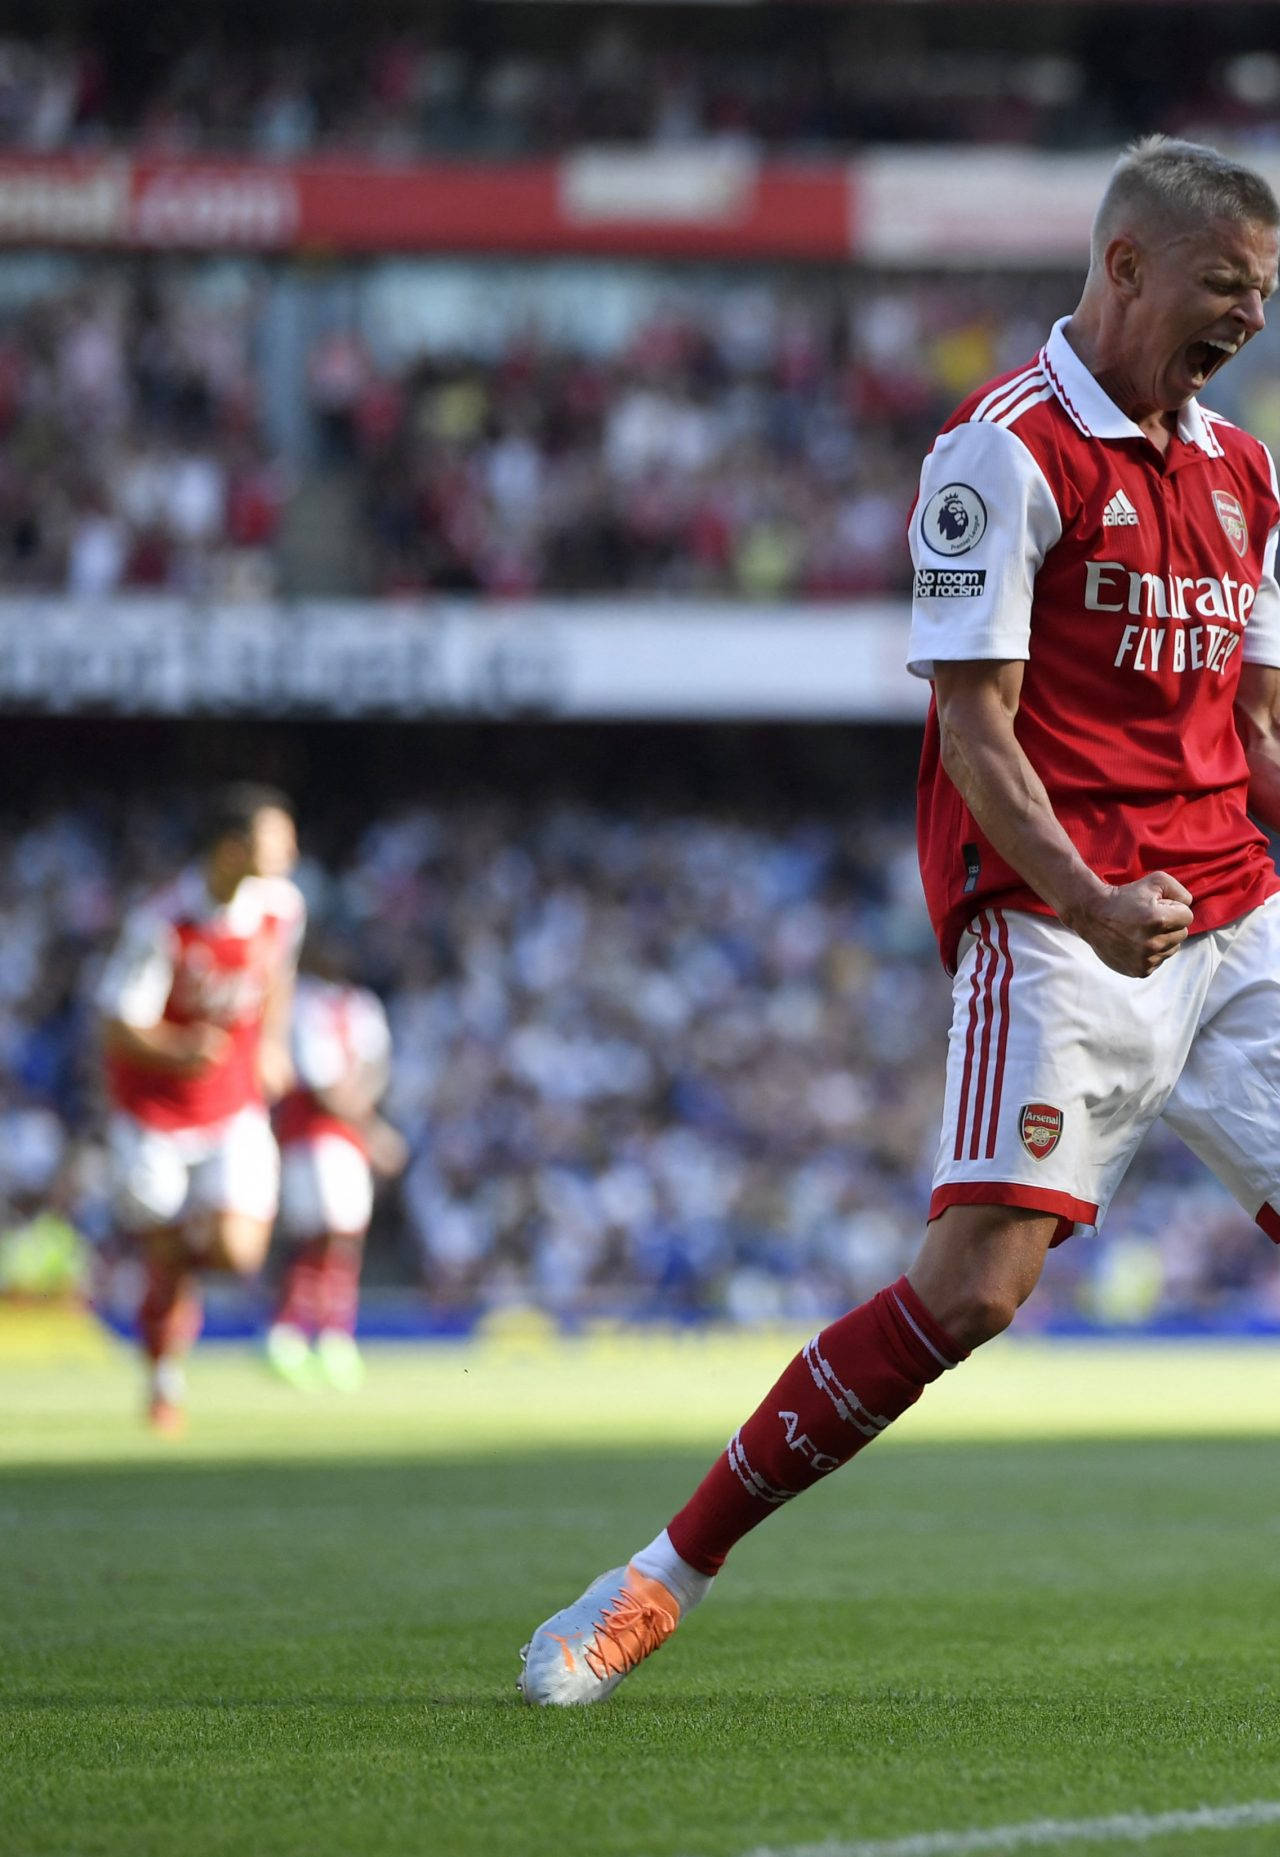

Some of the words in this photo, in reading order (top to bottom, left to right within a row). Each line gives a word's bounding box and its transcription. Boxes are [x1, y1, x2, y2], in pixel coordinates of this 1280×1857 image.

[915, 570, 935, 584] No
[937, 572, 979, 584] room
[915, 583, 934, 597] for
[935, 584, 984, 597] racism
[1114, 625, 1166, 672] FLY
[1025, 1112, 1059, 1125] Arsenal
[778, 1411, 839, 1471] AFC
